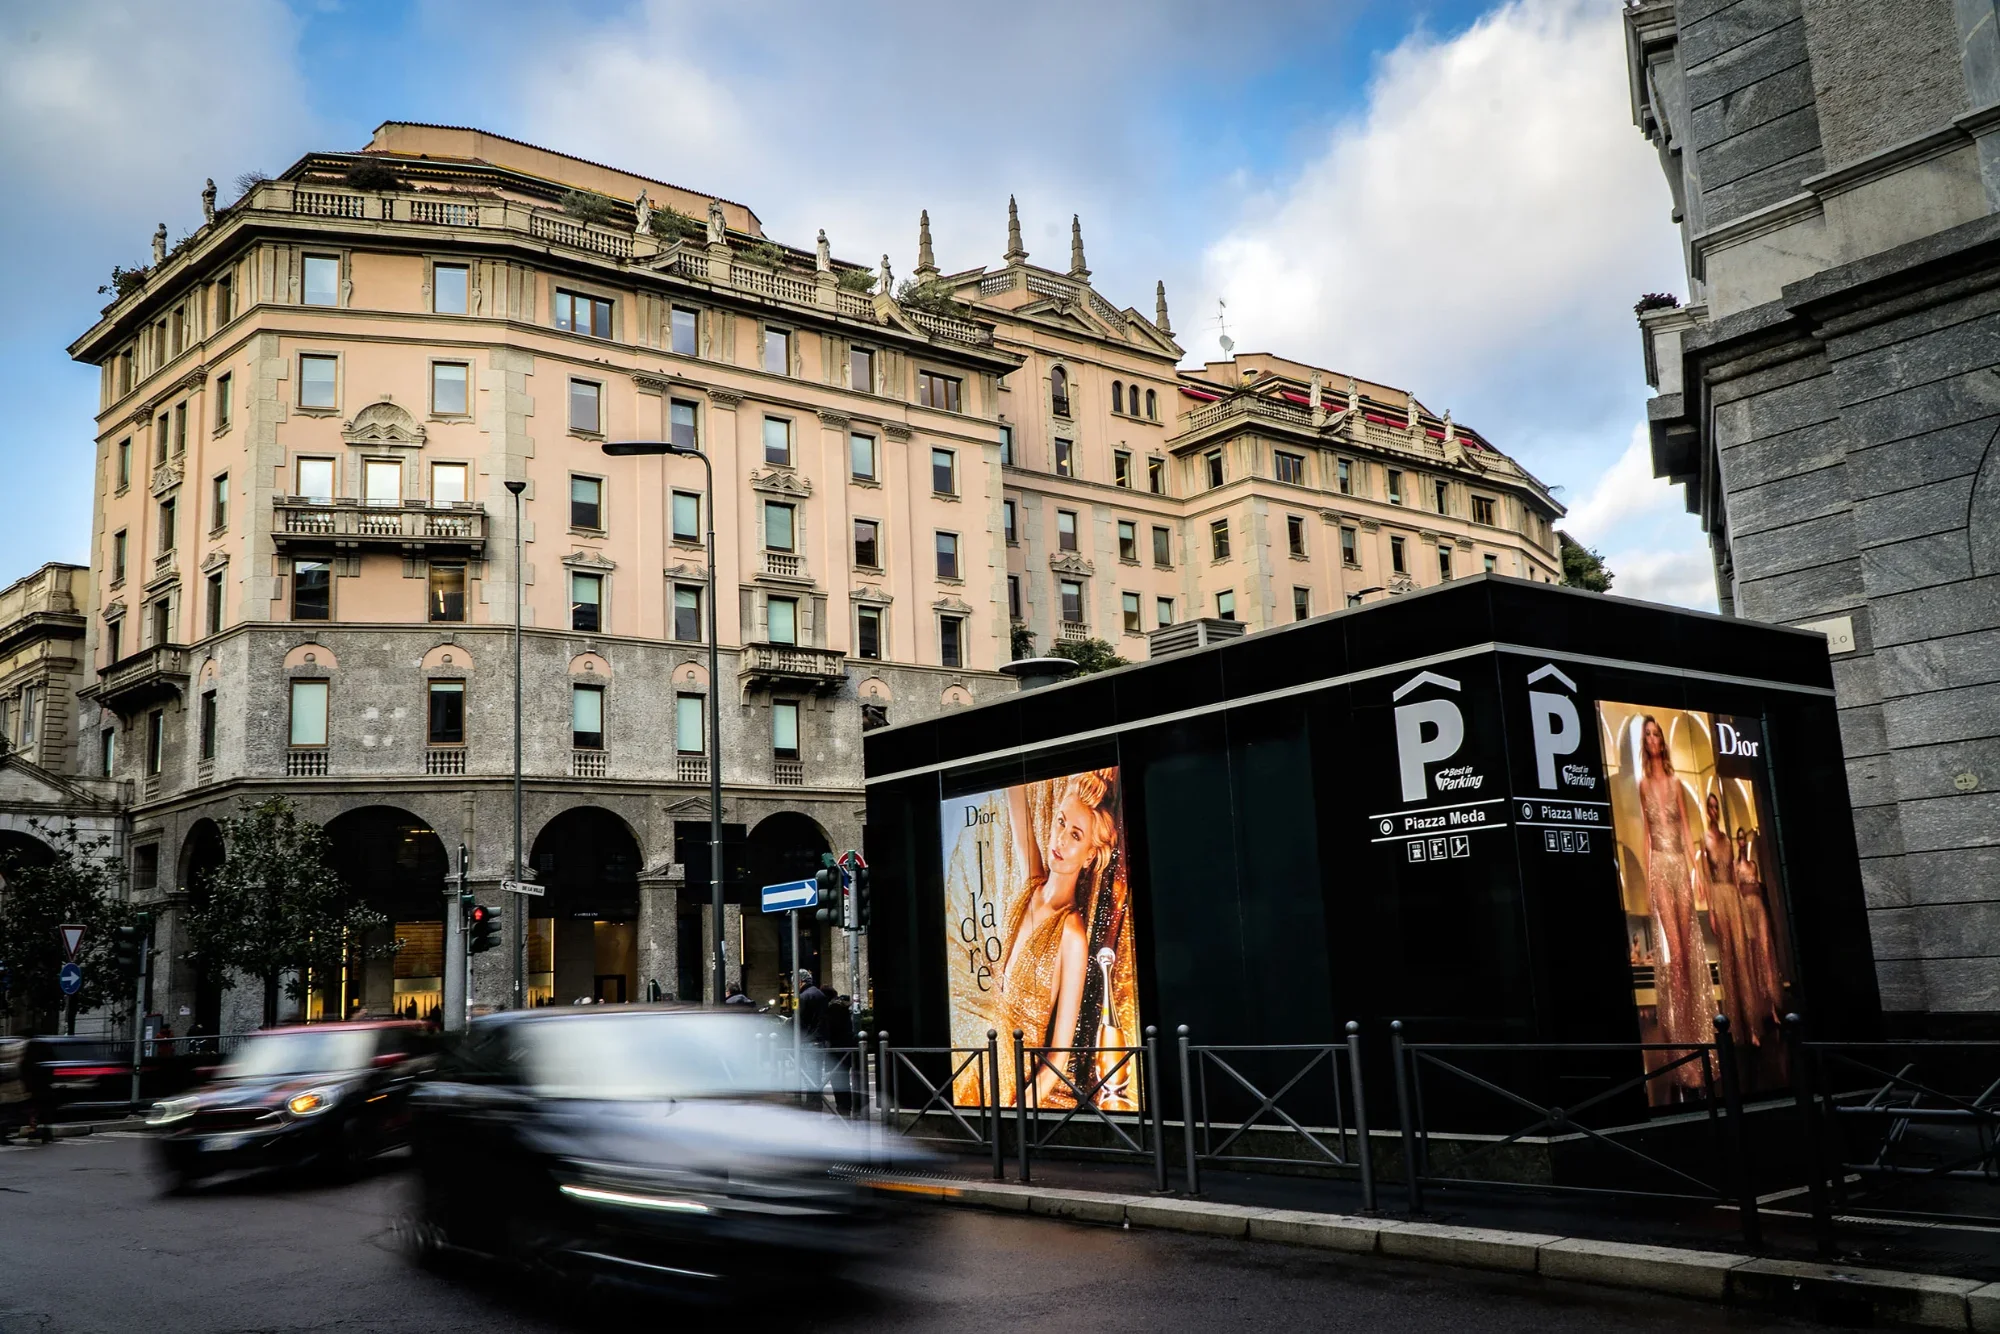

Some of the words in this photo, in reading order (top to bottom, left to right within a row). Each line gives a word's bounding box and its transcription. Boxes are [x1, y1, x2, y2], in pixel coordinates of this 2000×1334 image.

[1528, 690, 1581, 790] P
[1716, 722, 1758, 757] Dior
[1394, 699, 1464, 802] P
[1449, 767, 1466, 777] Best
[1465, 765, 1473, 774] in
[1571, 764, 1583, 773] Best
[1441, 774, 1484, 791] Parking
[1566, 773, 1596, 789] Parking
[964, 805, 996, 828] Dior
[1404, 815, 1446, 831] Piazza
[1449, 809, 1486, 825] Meda
[1541, 805, 1572, 820] Piazza
[1574, 807, 1599, 821] Meda
